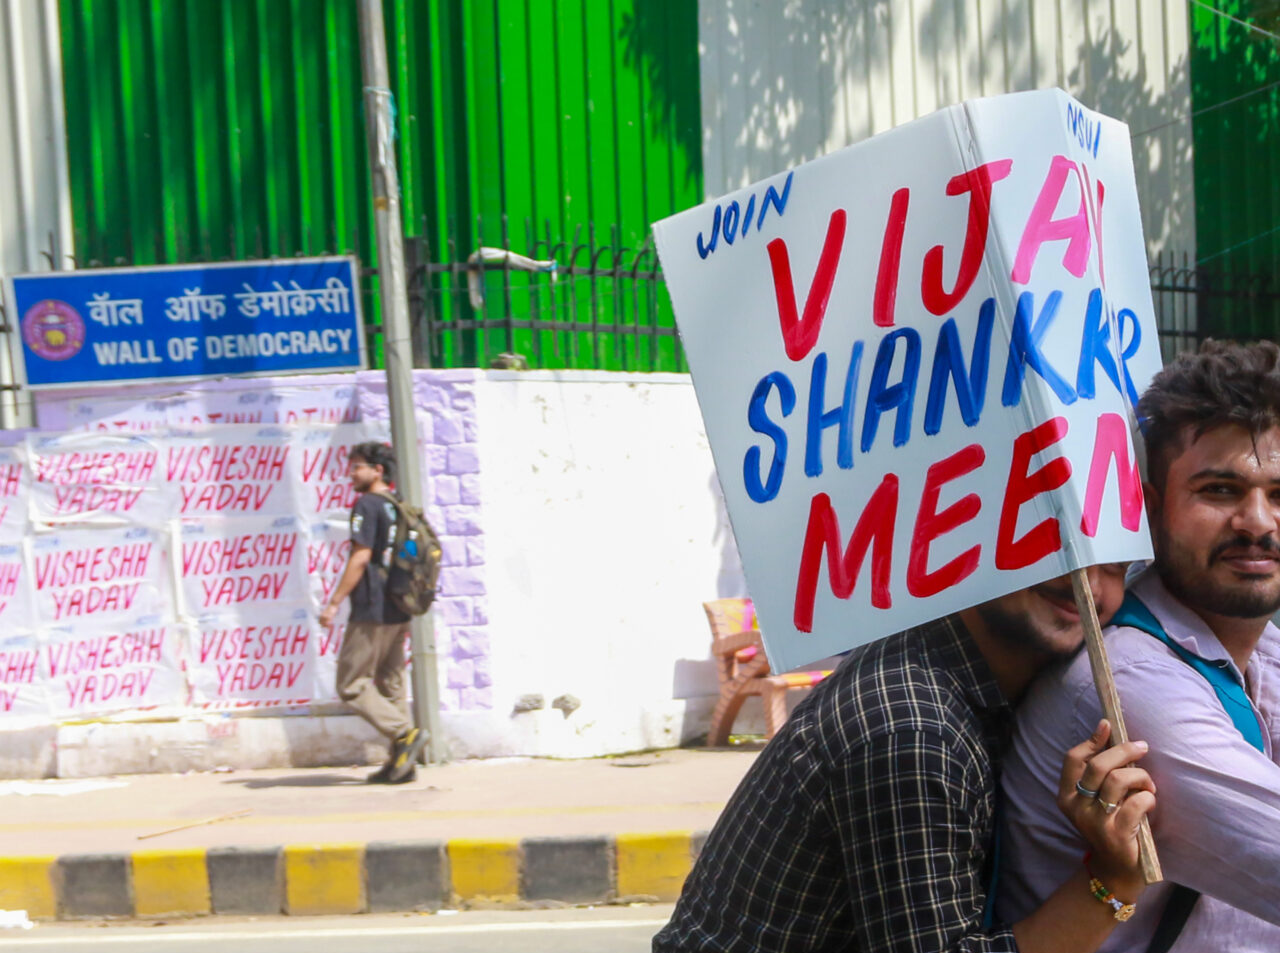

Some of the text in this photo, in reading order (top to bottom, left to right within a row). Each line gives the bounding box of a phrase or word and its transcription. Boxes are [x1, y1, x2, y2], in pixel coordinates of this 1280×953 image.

[697, 102, 1102, 260] JOIN NSUI
[86, 276, 350, 326] वॉल ऑफ डेमोक्रेसी
[93, 328, 353, 366] WALL OF DEMOCRACY
[167, 445, 291, 483] VISHESHH
[55, 486, 145, 515] YADAV
[180, 483, 274, 514] YADAV
[35, 543, 153, 591] VISHESHH
[182, 532, 297, 578] VISHESHH
[52, 582, 142, 620] YADAV
[201, 571, 289, 608] YADAV
[48, 627, 166, 679] VISHESHH
[66, 668, 155, 709] YADAV
[216, 661, 305, 696] YADAV
